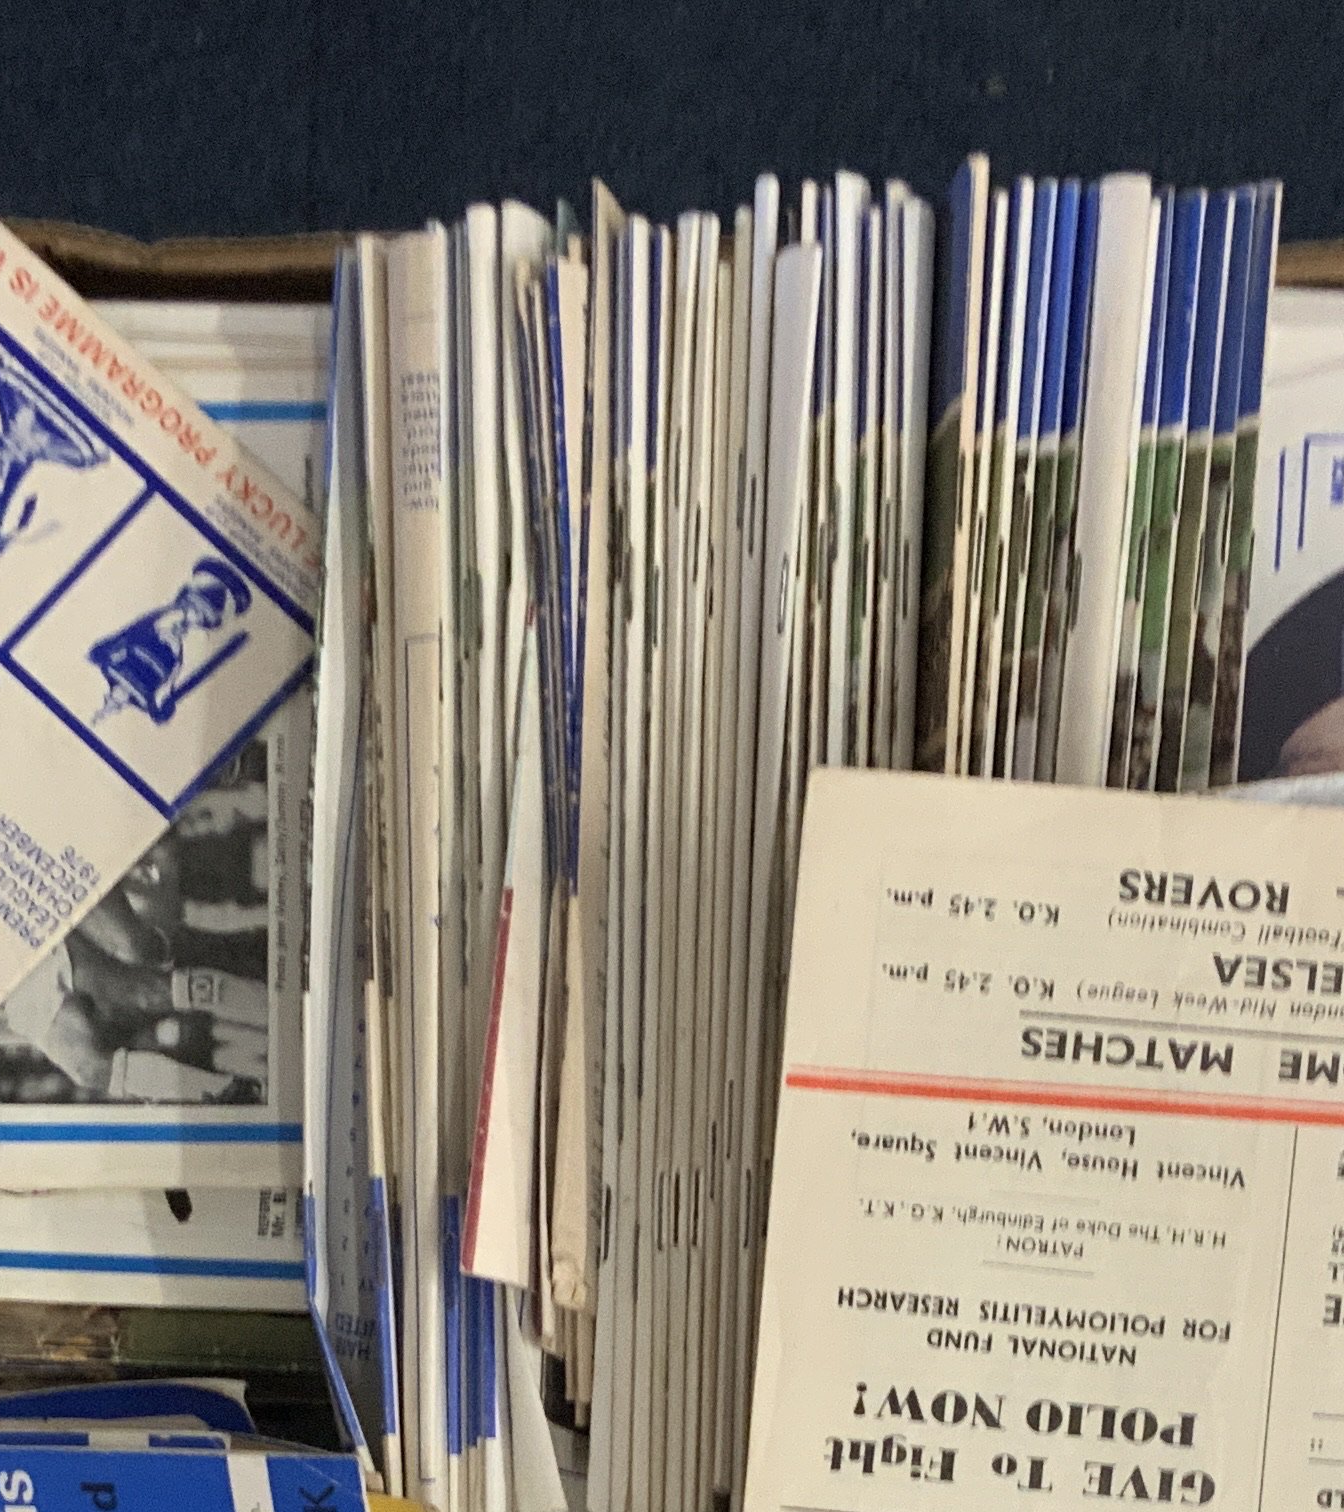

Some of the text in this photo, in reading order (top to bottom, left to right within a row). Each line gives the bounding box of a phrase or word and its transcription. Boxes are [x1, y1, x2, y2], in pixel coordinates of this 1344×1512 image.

[6, 265, 41, 305] IS
[36, 292, 219, 471] PROGRAMME
[213, 459, 307, 552] LUCKY
[1117, 867, 1291, 918] ROVERS
[880, 961, 1056, 1002] K.O. 2.45 p.m.
[1019, 1024, 1235, 1077] MATCHES
[849, 1127, 1246, 1190] Vincent House, Vincent Square,
[1041, 1114, 1137, 1148] London,
[835, 1284, 1232, 1343] FOR POLIOMYELITIS RESEARCH
[925, 1326, 1137, 1367] NATIONAL FUND
[851, 1380, 1197, 1449] POLIO NOW!
[822, 1432, 1216, 1507] GIVE To Fight
